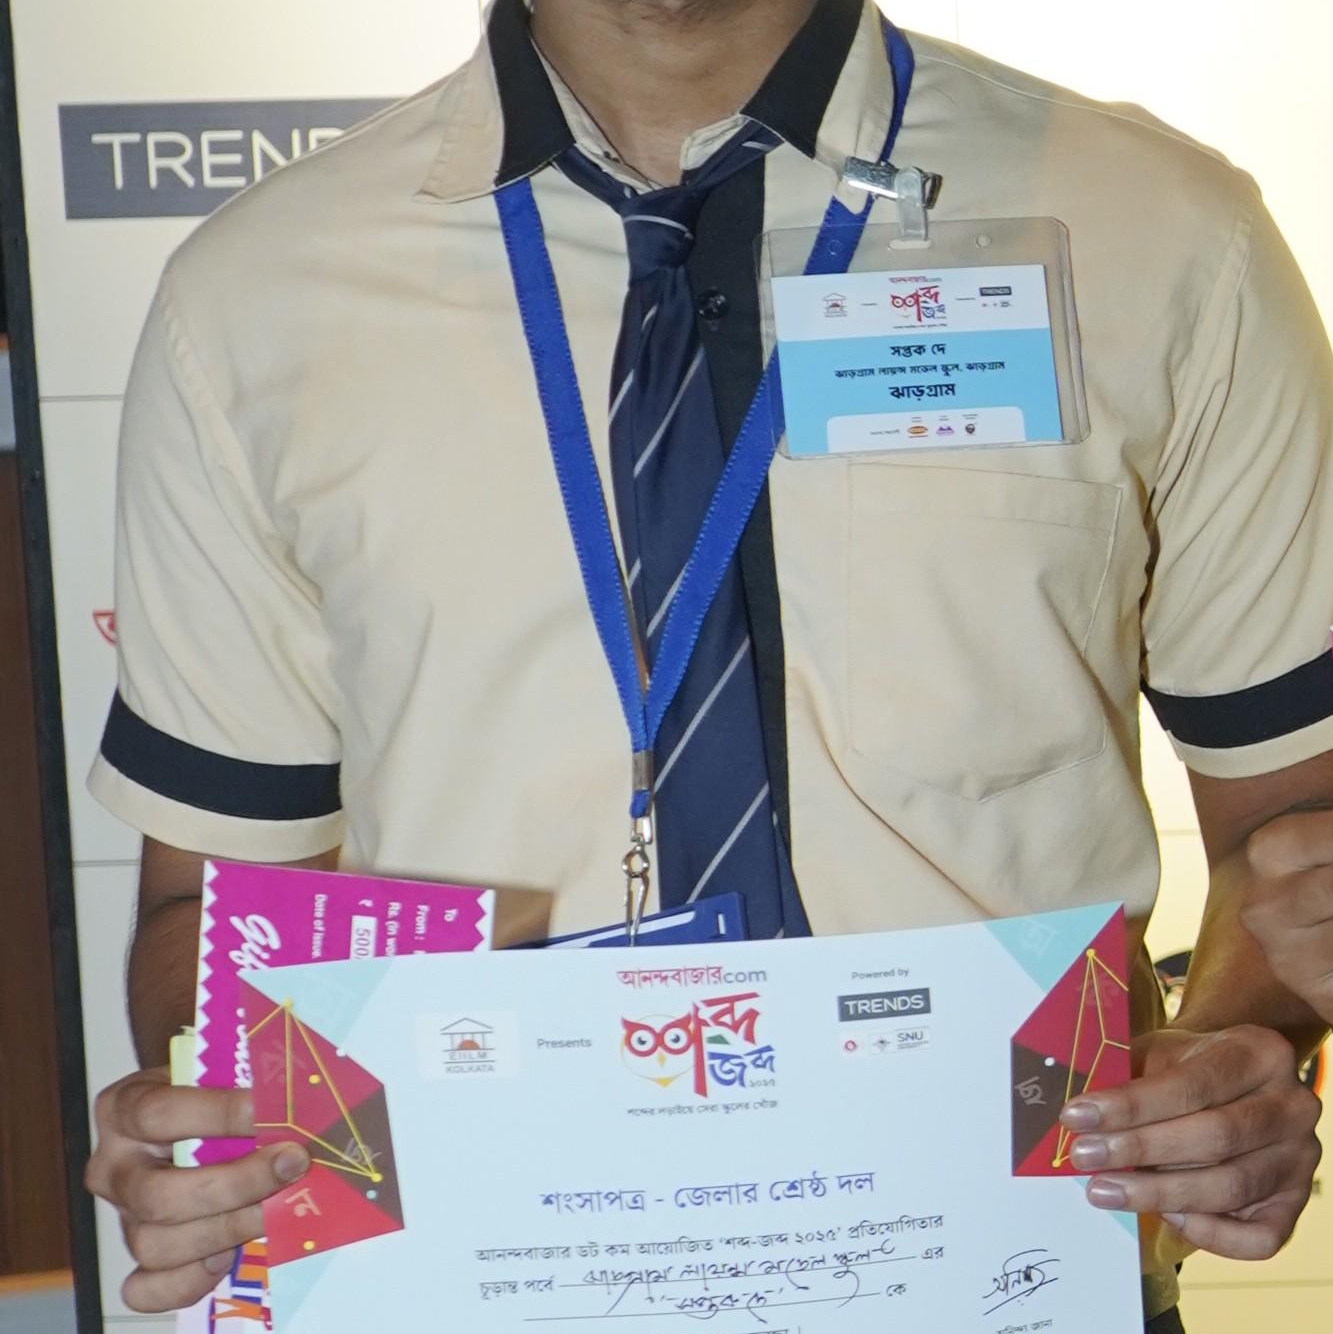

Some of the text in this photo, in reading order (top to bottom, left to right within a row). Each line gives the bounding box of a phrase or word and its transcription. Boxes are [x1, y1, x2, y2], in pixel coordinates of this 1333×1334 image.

[931, 342, 947, 356] দে
[889, 383, 956, 401] ঝাড়গ্রাম
[443, 909, 458, 922] To
[851, 967, 910, 980] Powered by
[844, 994, 925, 1015] TRENDS
[537, 1036, 593, 1050] Presents
[897, 1031, 924, 1043] SNU
[539, 1171, 875, 1214] শংসাপত্র জেলার শ্রেষ্ঠ দল
[475, 1215, 944, 1262] আনন্দবাজার ডট কম আয়োজিত প্রতিযোগিতার
[524, 1275, 555, 1292] পর্বে
[921, 1246, 944, 1260] এর
[886, 1282, 907, 1297] কে
